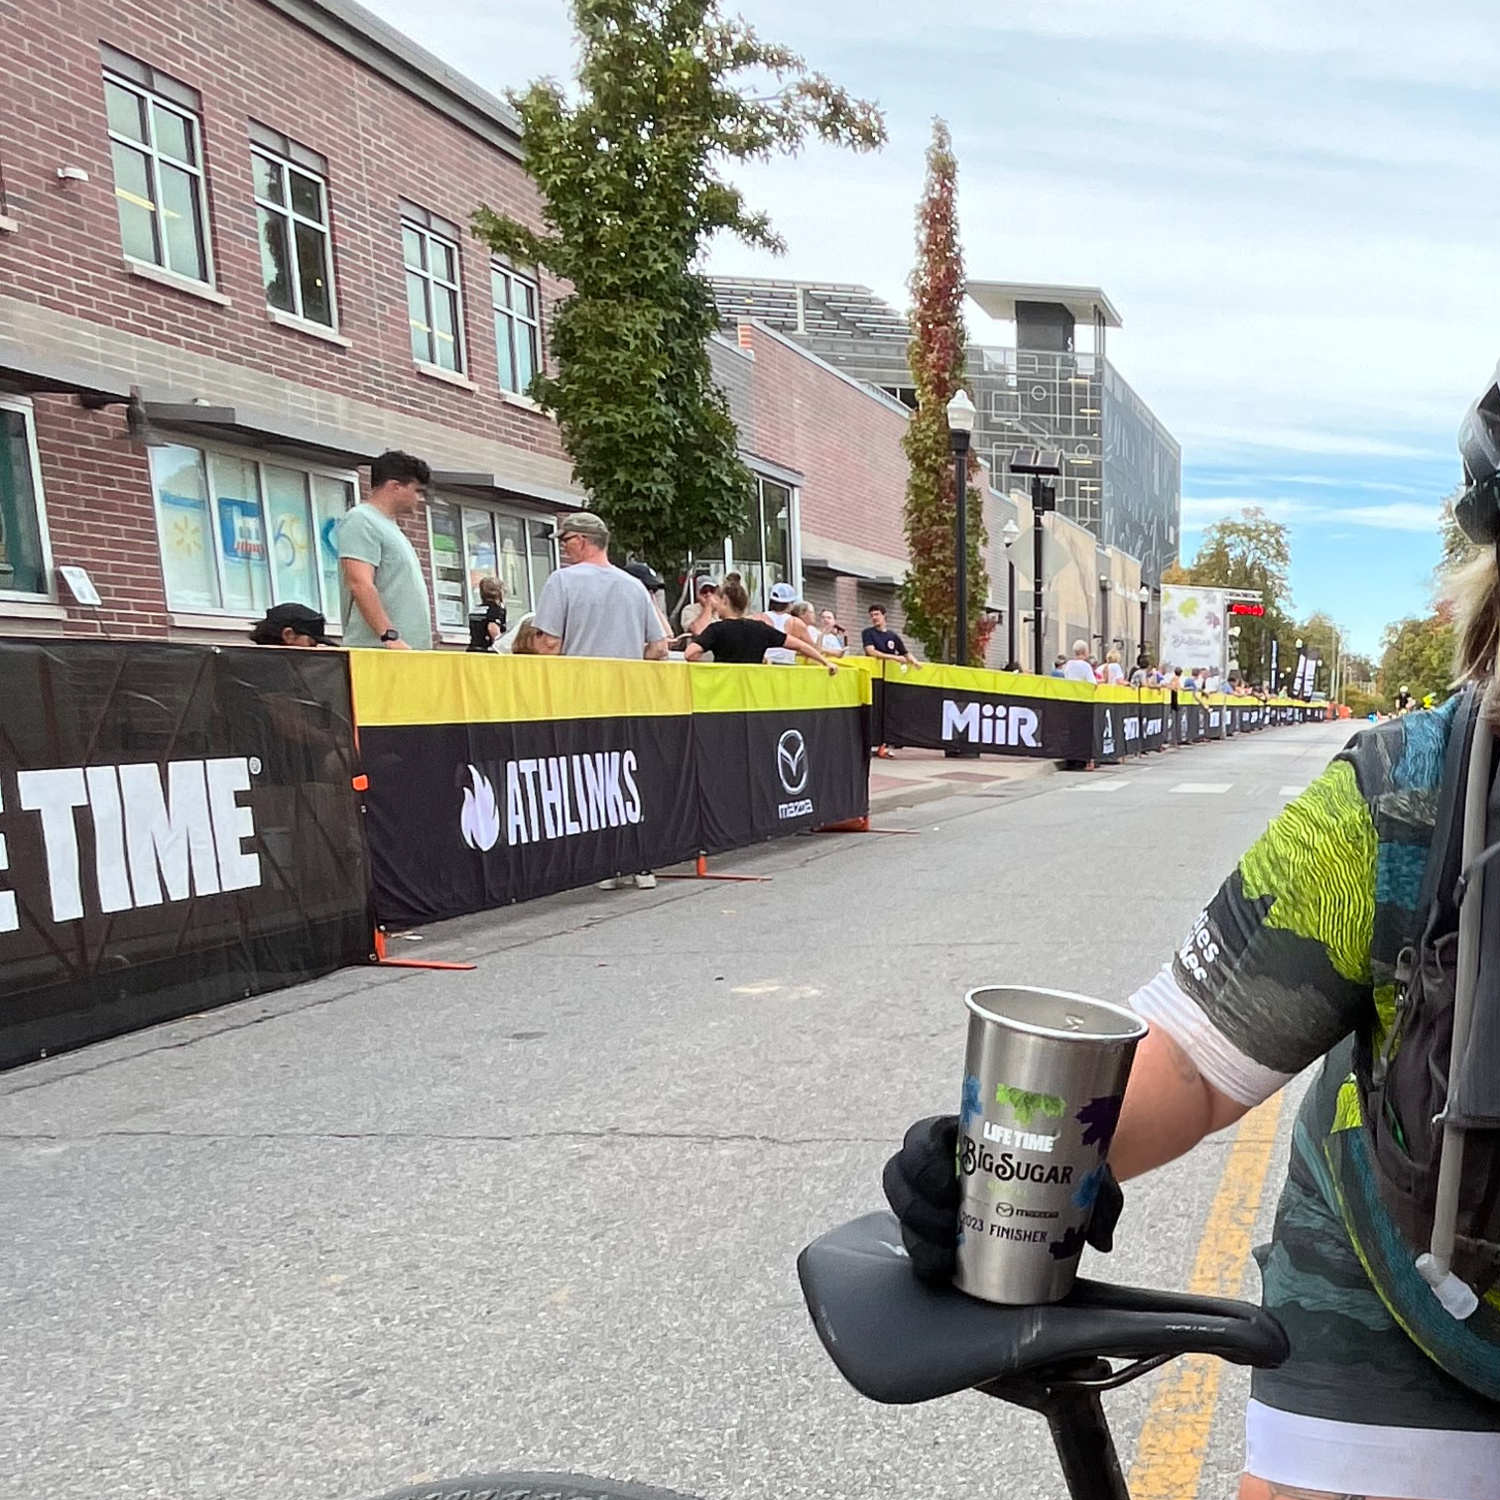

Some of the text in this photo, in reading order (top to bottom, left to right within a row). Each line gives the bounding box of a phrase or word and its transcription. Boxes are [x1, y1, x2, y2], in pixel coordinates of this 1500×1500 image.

[941, 699, 1040, 748] MiiR
[506, 749, 642, 847] ATHLINKS
[16, 757, 263, 924] TIME
[982, 1120, 1055, 1153] LIFE TIME
[988, 1223, 1049, 1243] FINISHER
